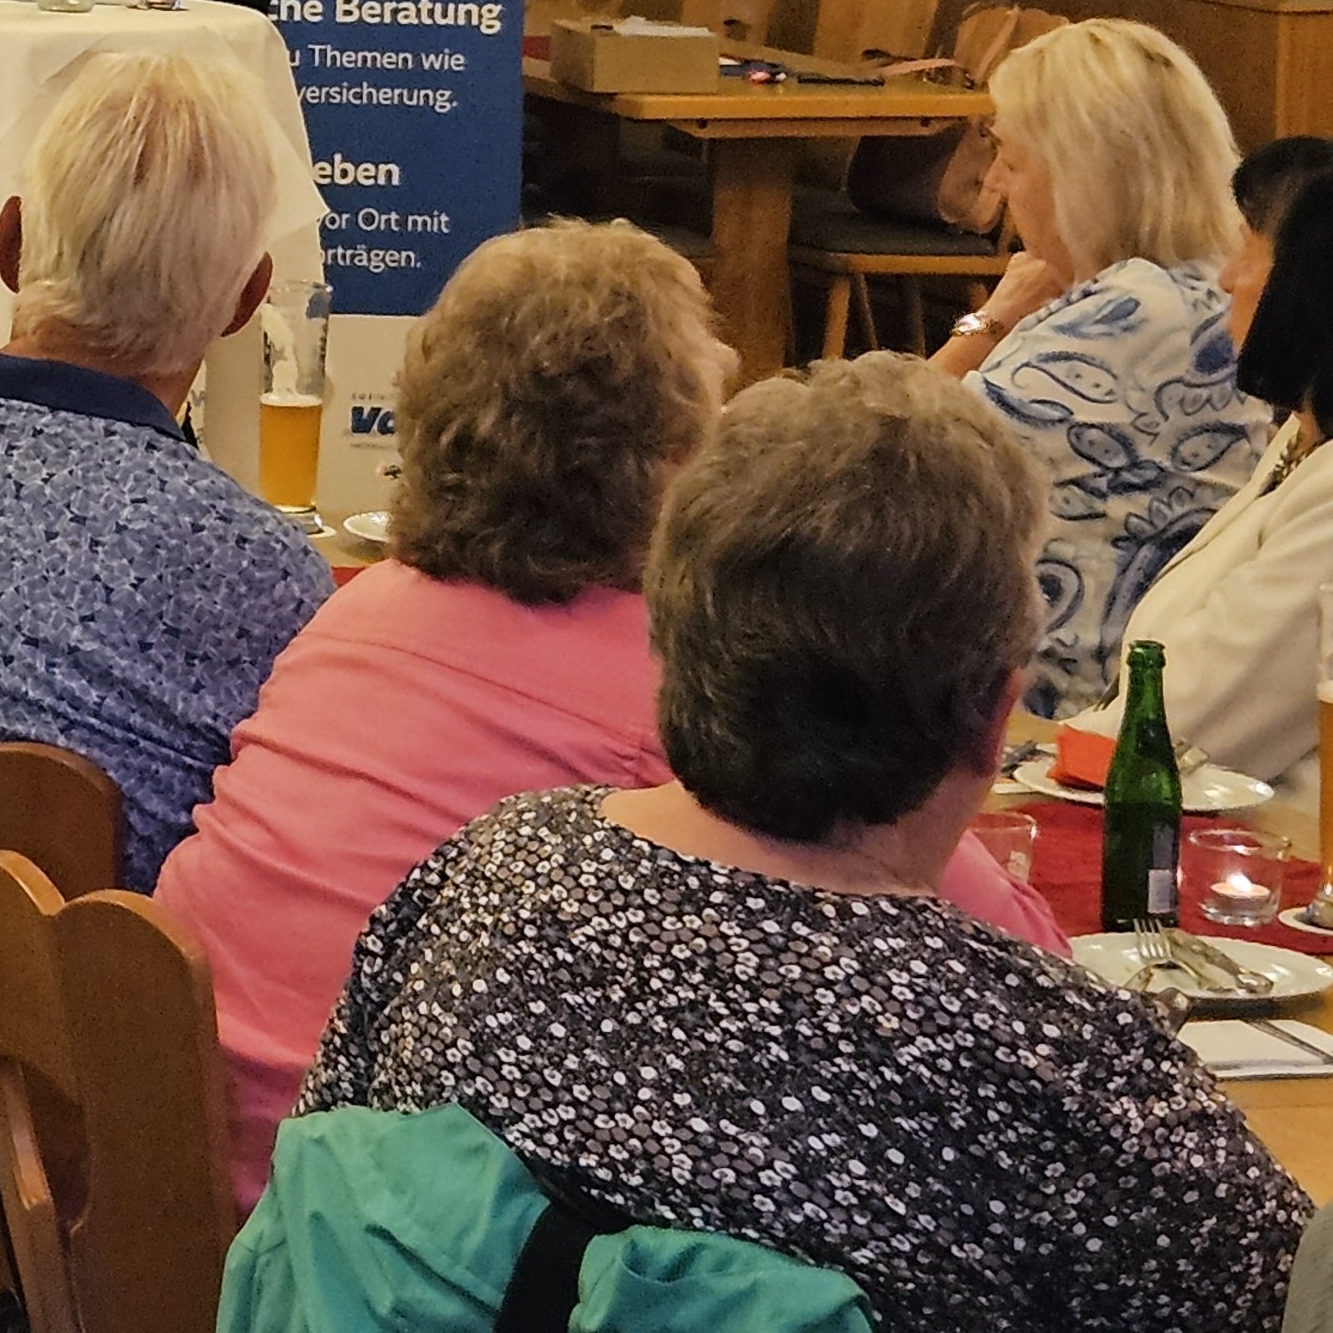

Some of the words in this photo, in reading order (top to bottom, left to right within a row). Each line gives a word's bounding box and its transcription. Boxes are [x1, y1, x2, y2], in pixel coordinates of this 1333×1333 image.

[308, 44, 412, 69] Themen
[421, 48, 466, 71] wie
[320, 212, 351, 230] or
[358, 208, 399, 231] Ort
[408, 210, 451, 233] mit
[321, 243, 421, 273] rträgen.
